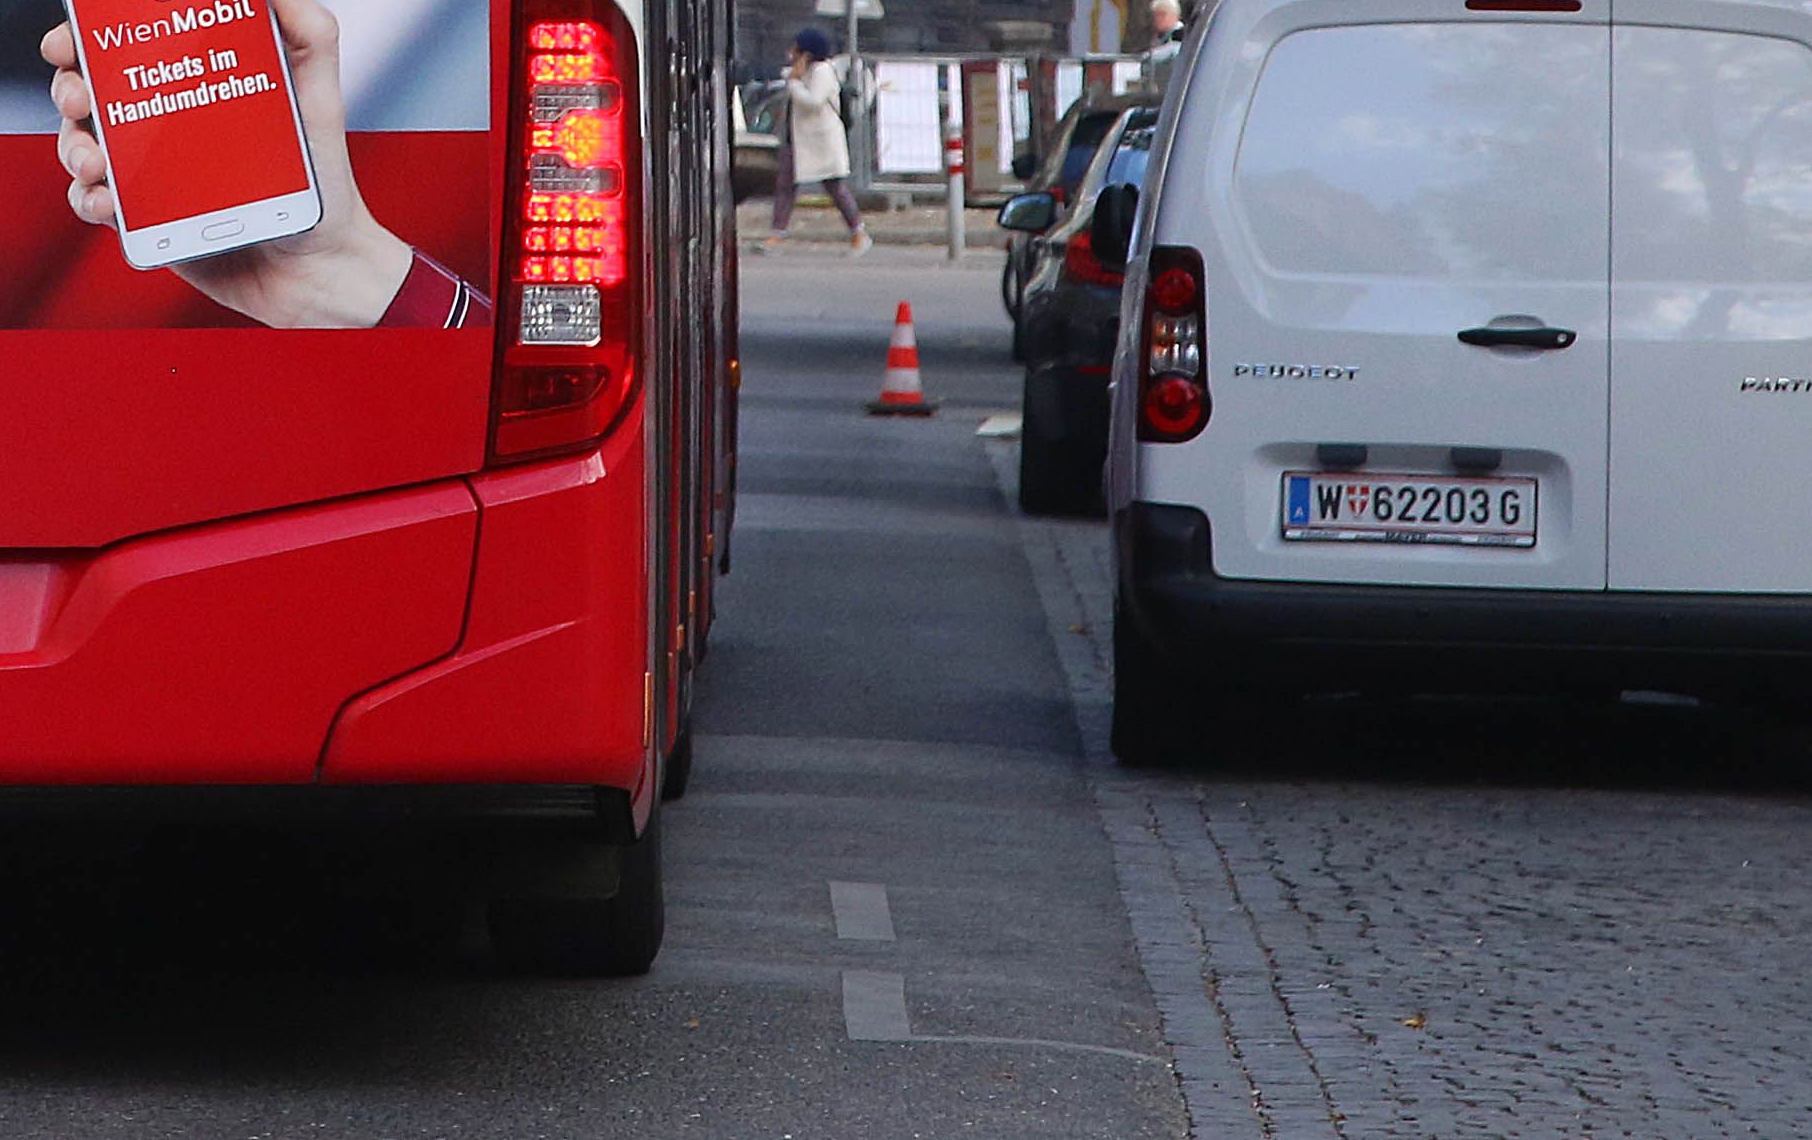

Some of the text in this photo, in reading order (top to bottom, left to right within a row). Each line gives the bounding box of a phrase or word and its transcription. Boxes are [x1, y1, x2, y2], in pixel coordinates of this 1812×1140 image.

[123, 47, 238, 91] Tickets im
[106, 70, 278, 126] Handumdrehen.
[1235, 363, 1360, 380] PEUGEOT
[1741, 376, 1812, 392] PART
[1317, 484, 1343, 520] W
[1373, 485, 1489, 524] 62203
[1500, 489, 1520, 525] G
